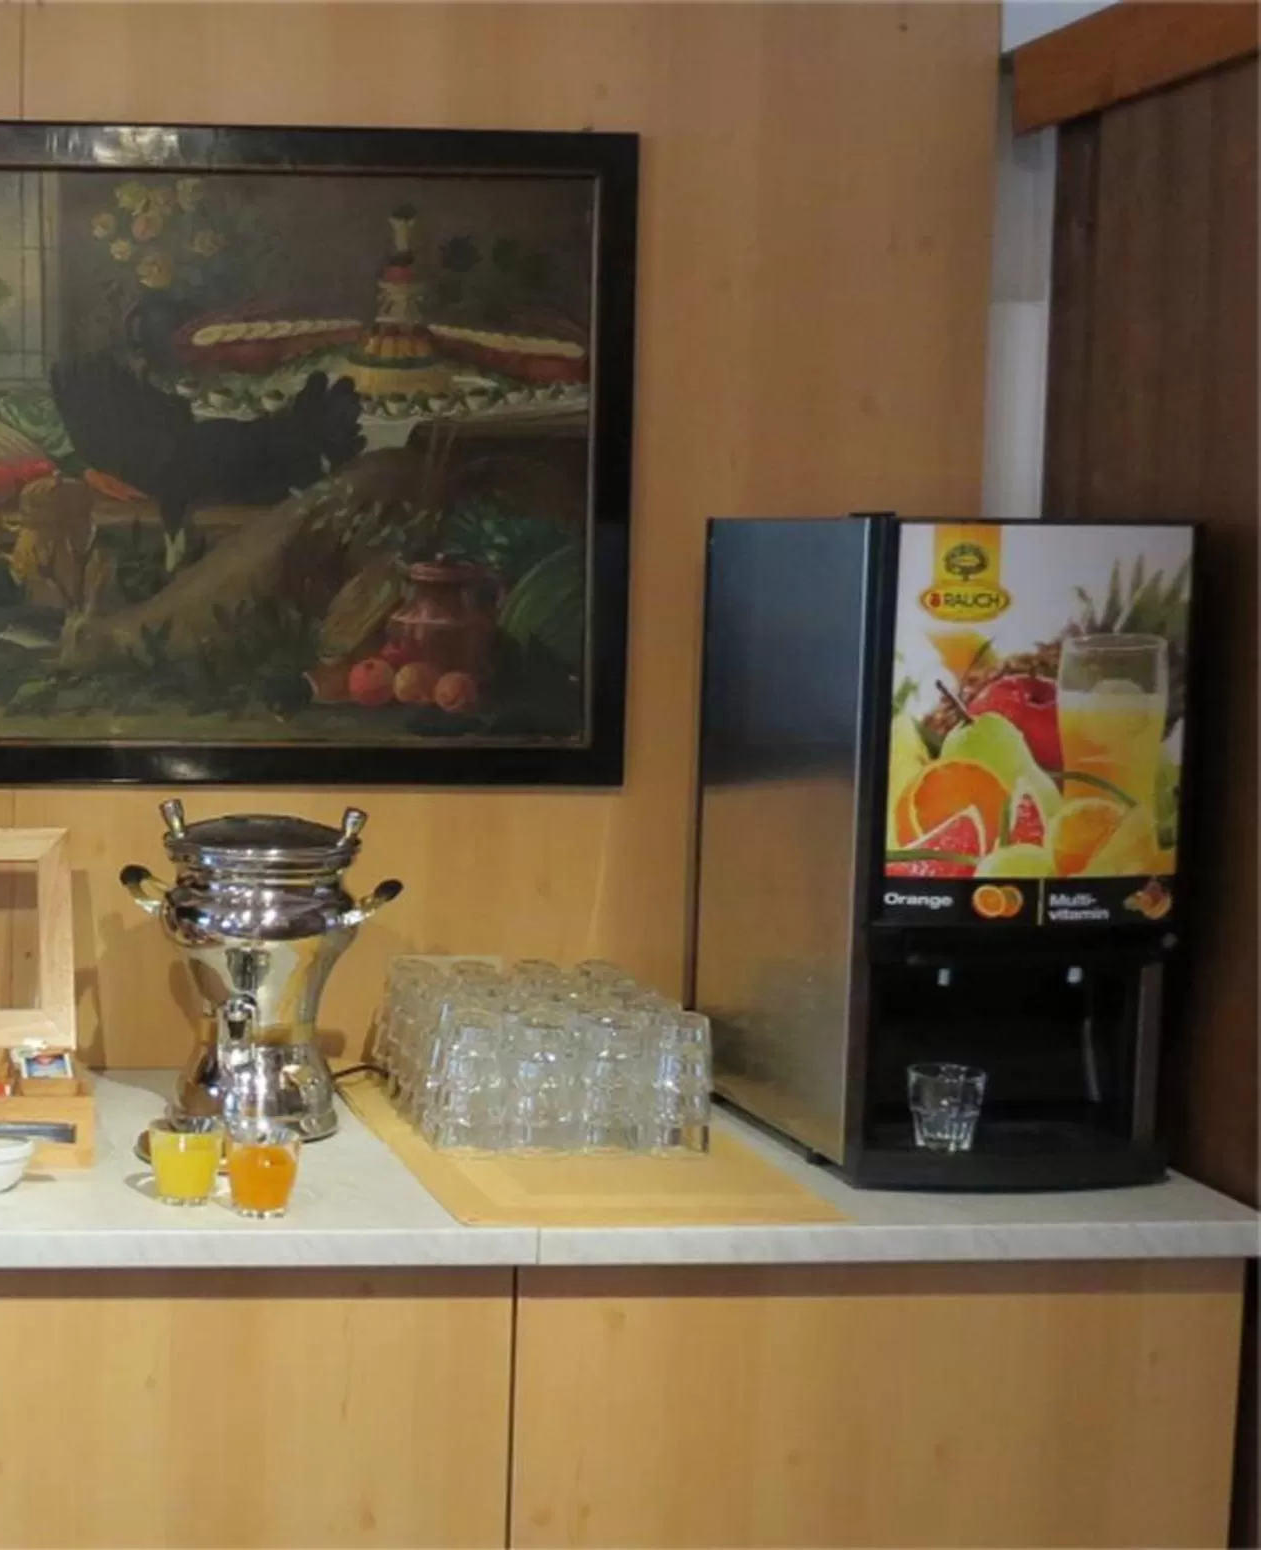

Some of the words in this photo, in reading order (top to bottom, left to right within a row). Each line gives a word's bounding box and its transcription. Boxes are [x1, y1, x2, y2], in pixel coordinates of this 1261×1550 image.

[943, 592, 1000, 609] RAUCH
[884, 891, 953, 909] Orange
[1048, 907, 1110, 921] vitamin
